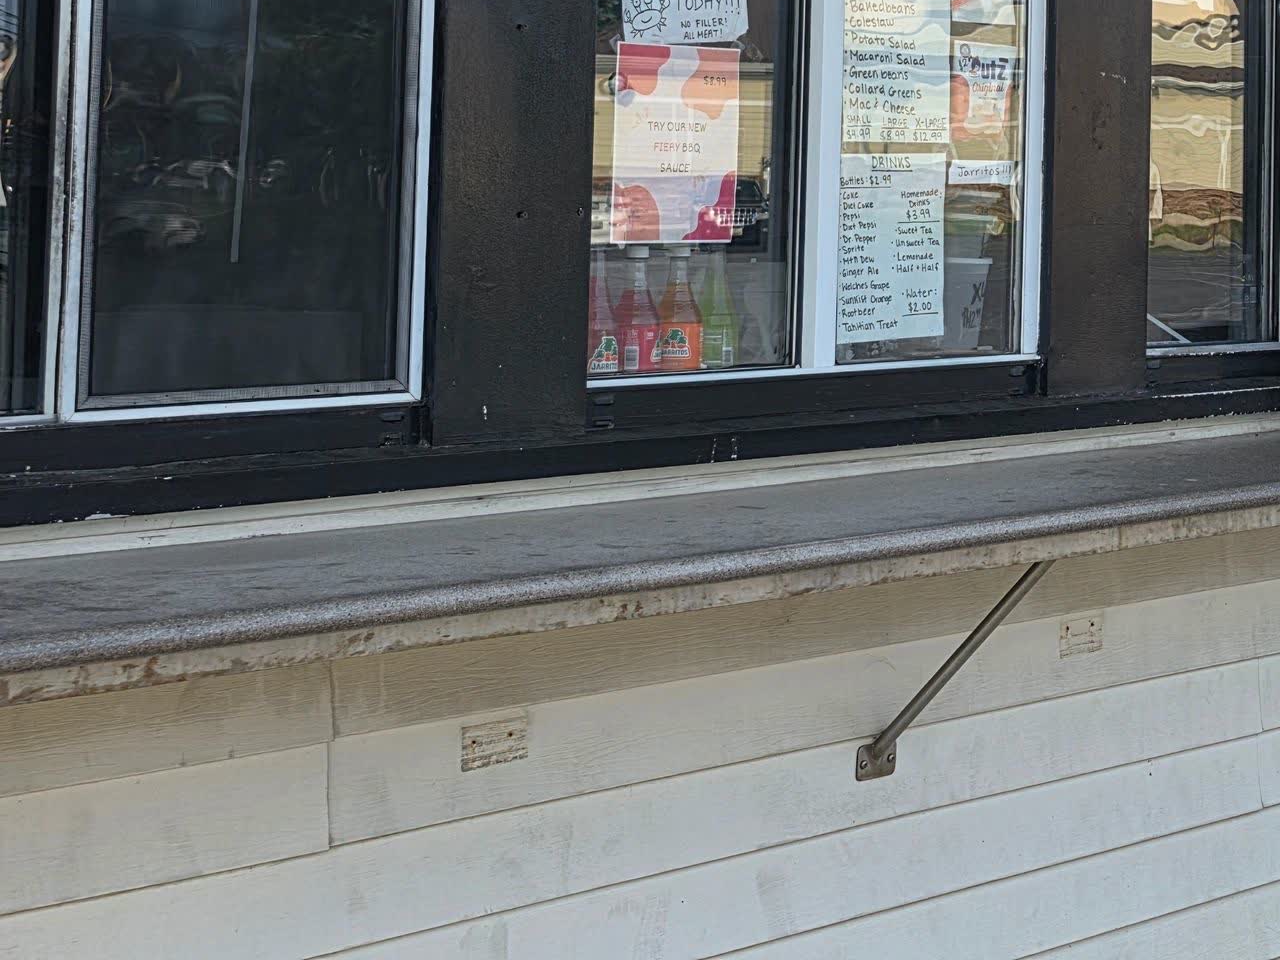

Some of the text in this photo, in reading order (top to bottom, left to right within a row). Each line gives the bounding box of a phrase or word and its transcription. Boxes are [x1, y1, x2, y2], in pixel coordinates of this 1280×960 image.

[681, 17, 728, 28] NO FILLER!
[684, 29, 723, 40] ALL MEAT!
[849, 50, 925, 66] Macaroni Salad
[648, 121, 706, 132] TRY OUR NEW
[660, 163, 690, 173] SAUCE
[871, 156, 912, 169] DRINKS
